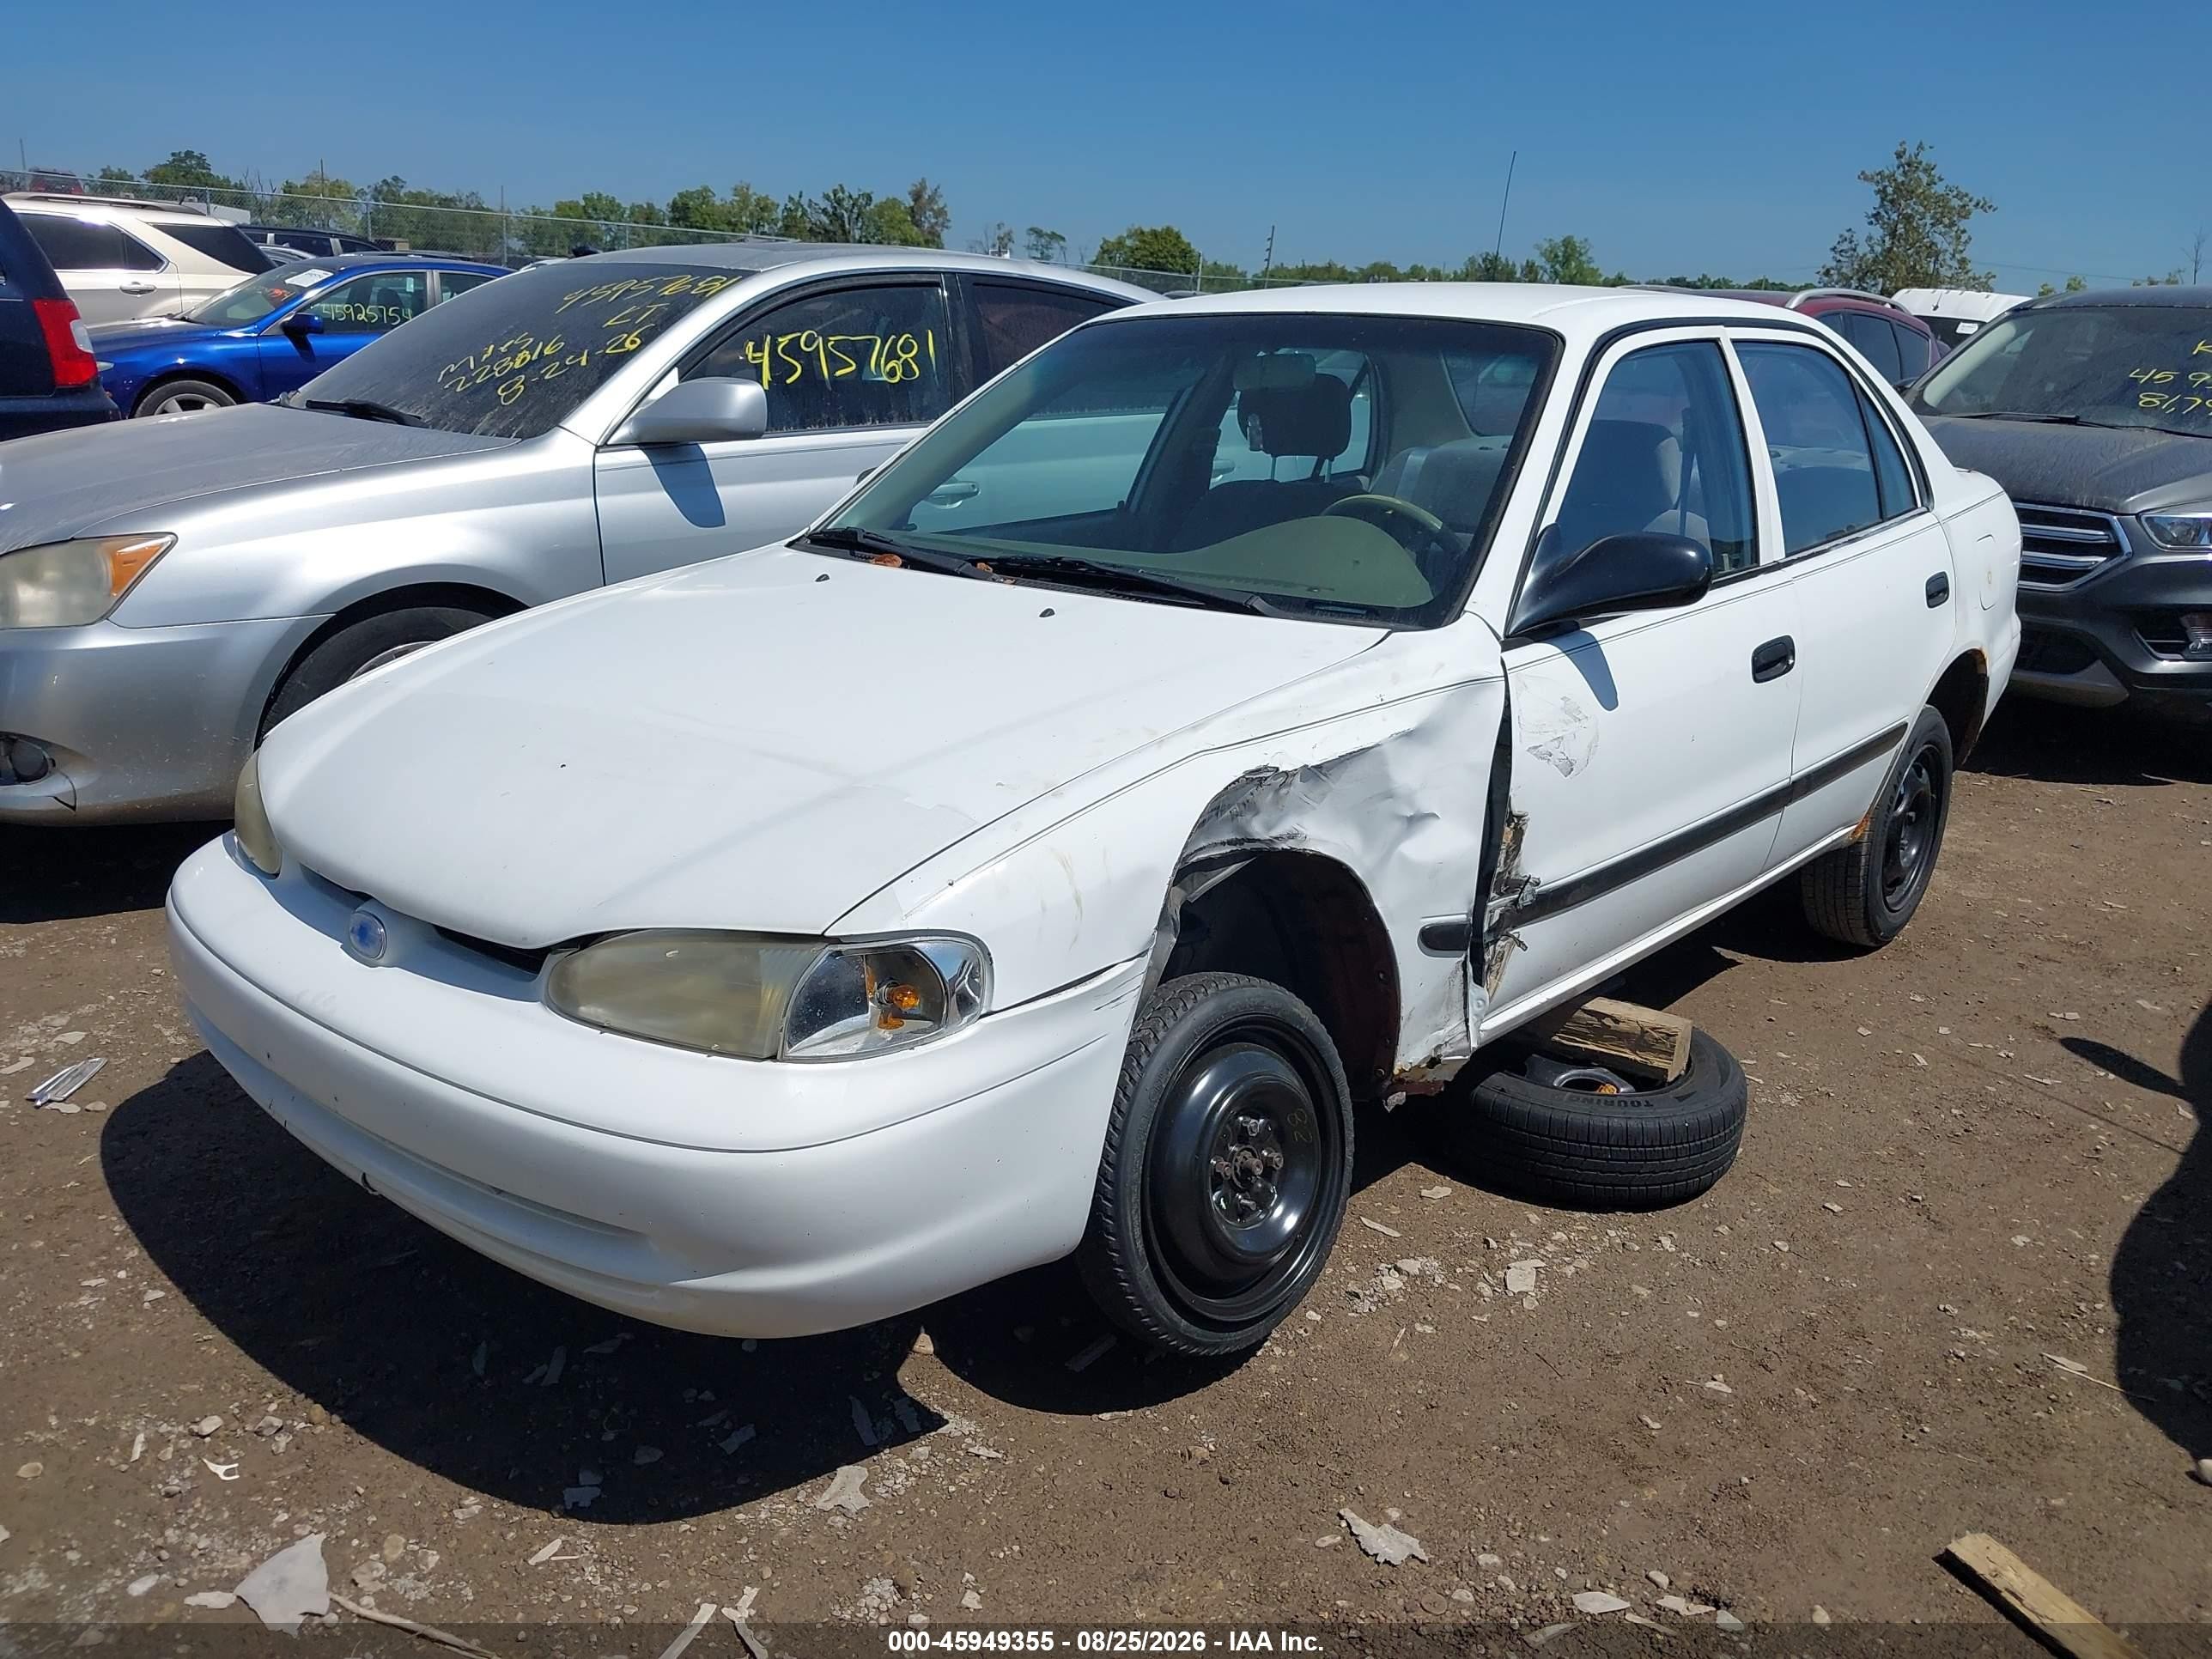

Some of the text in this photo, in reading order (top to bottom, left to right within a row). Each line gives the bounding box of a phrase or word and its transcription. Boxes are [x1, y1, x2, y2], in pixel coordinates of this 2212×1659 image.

[555, 275, 743, 314] 45957681
[322, 302, 412, 325] 45925754
[745, 329, 940, 392] 45957681
[1570, 1095, 1654, 1109] TOURING
